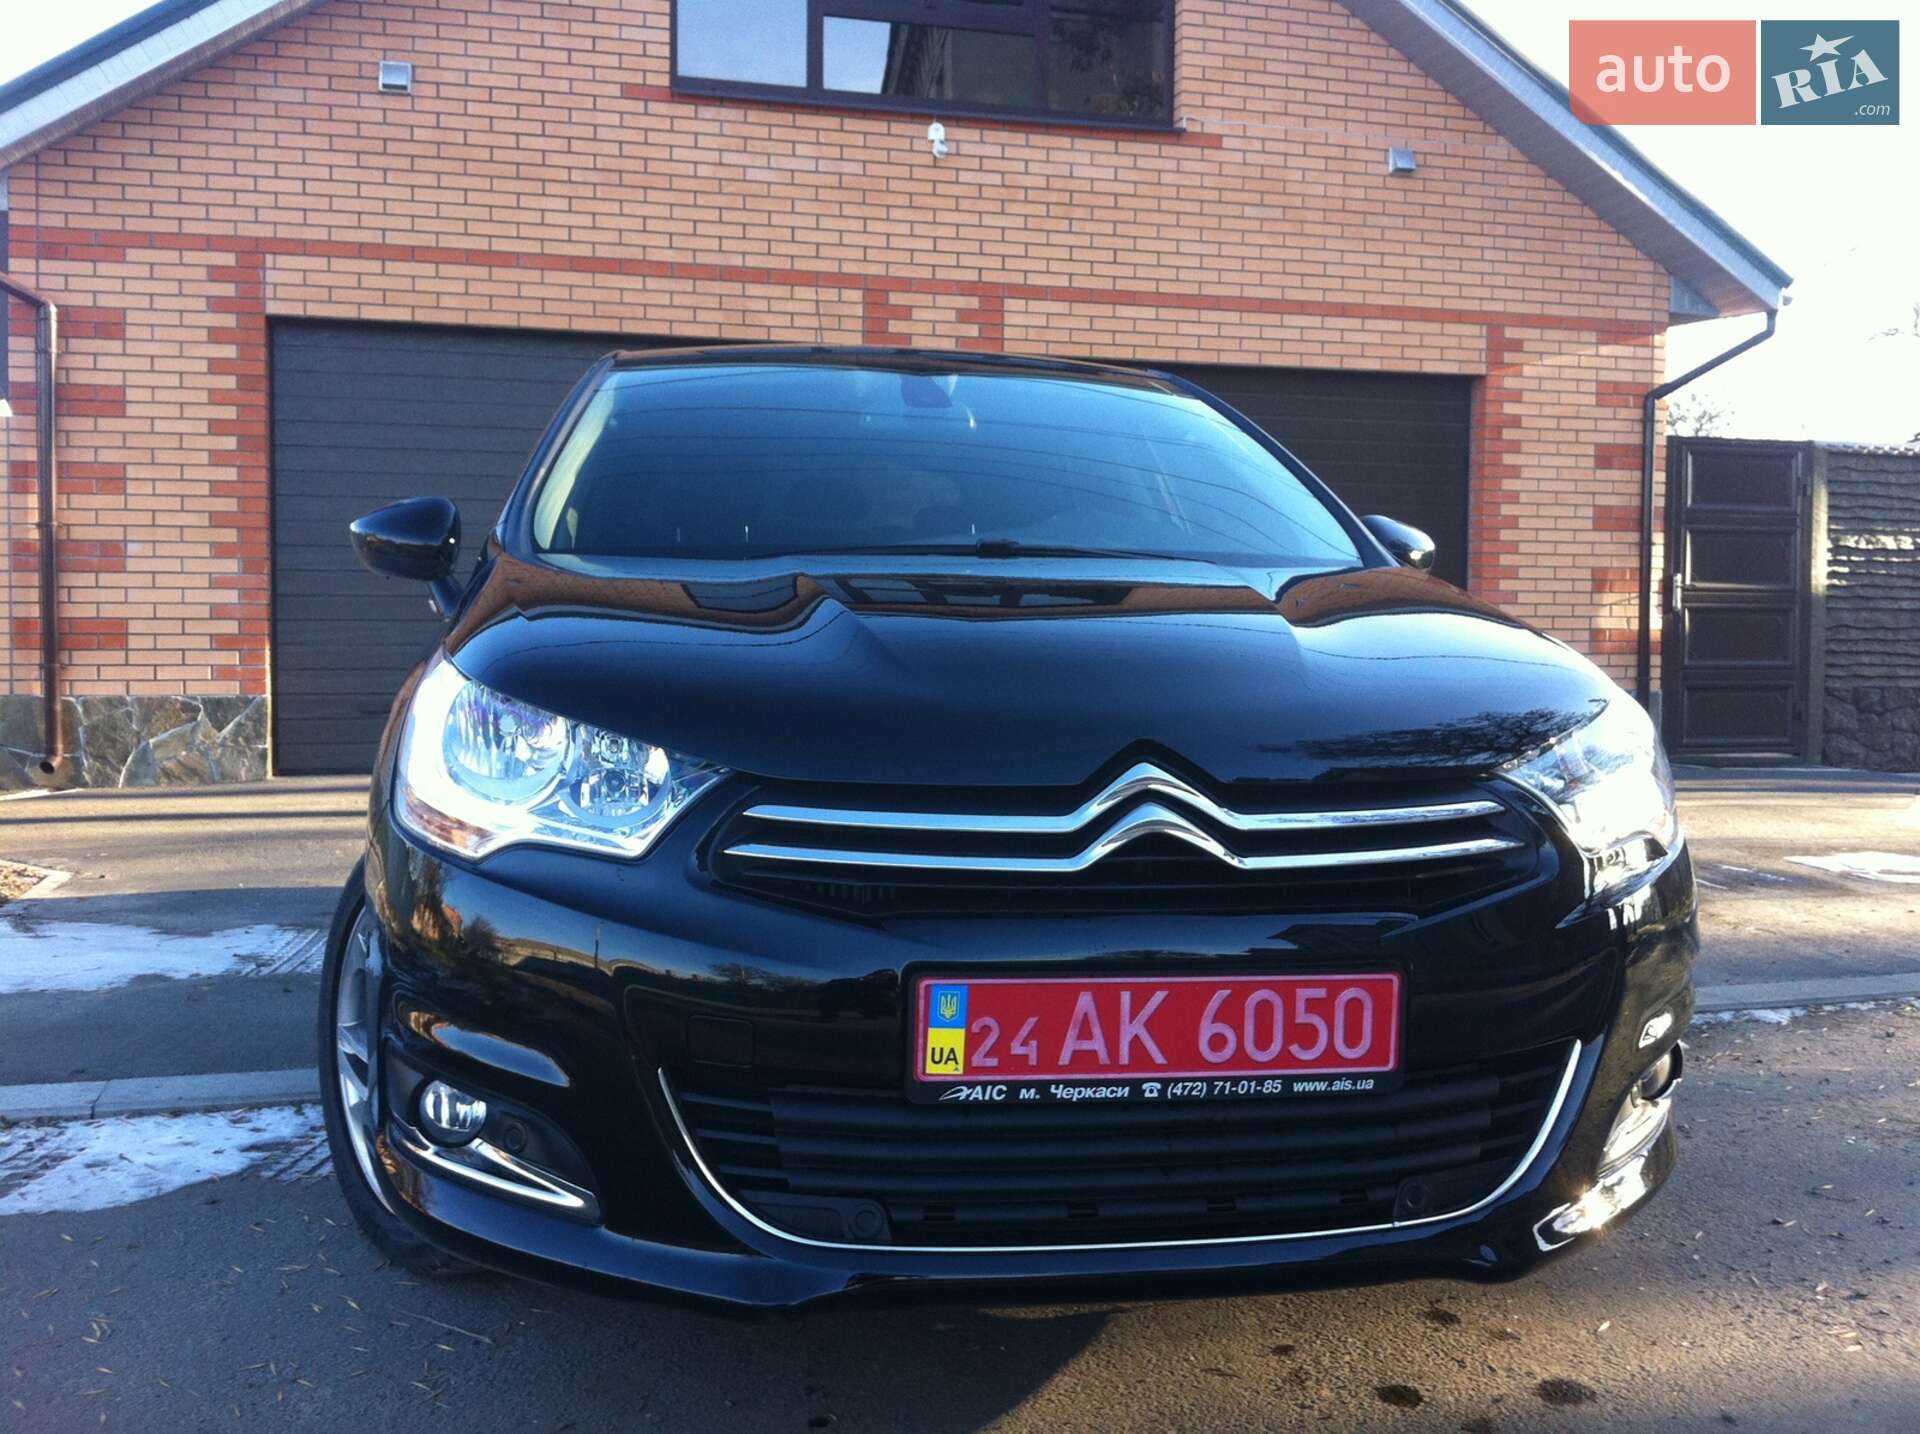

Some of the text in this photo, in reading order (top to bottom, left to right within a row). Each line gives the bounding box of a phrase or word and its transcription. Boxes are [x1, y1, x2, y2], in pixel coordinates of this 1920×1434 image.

[971, 987, 1373, 1067] 24 AK 6050
[930, 1046, 959, 1065] UA
[1050, 1084, 1130, 1101] Черкаси
[1167, 1081, 1207, 1098] (472)
[1213, 1079, 1282, 1095] 71-01-85
[1293, 1077, 1374, 1092] www.ais.ua
